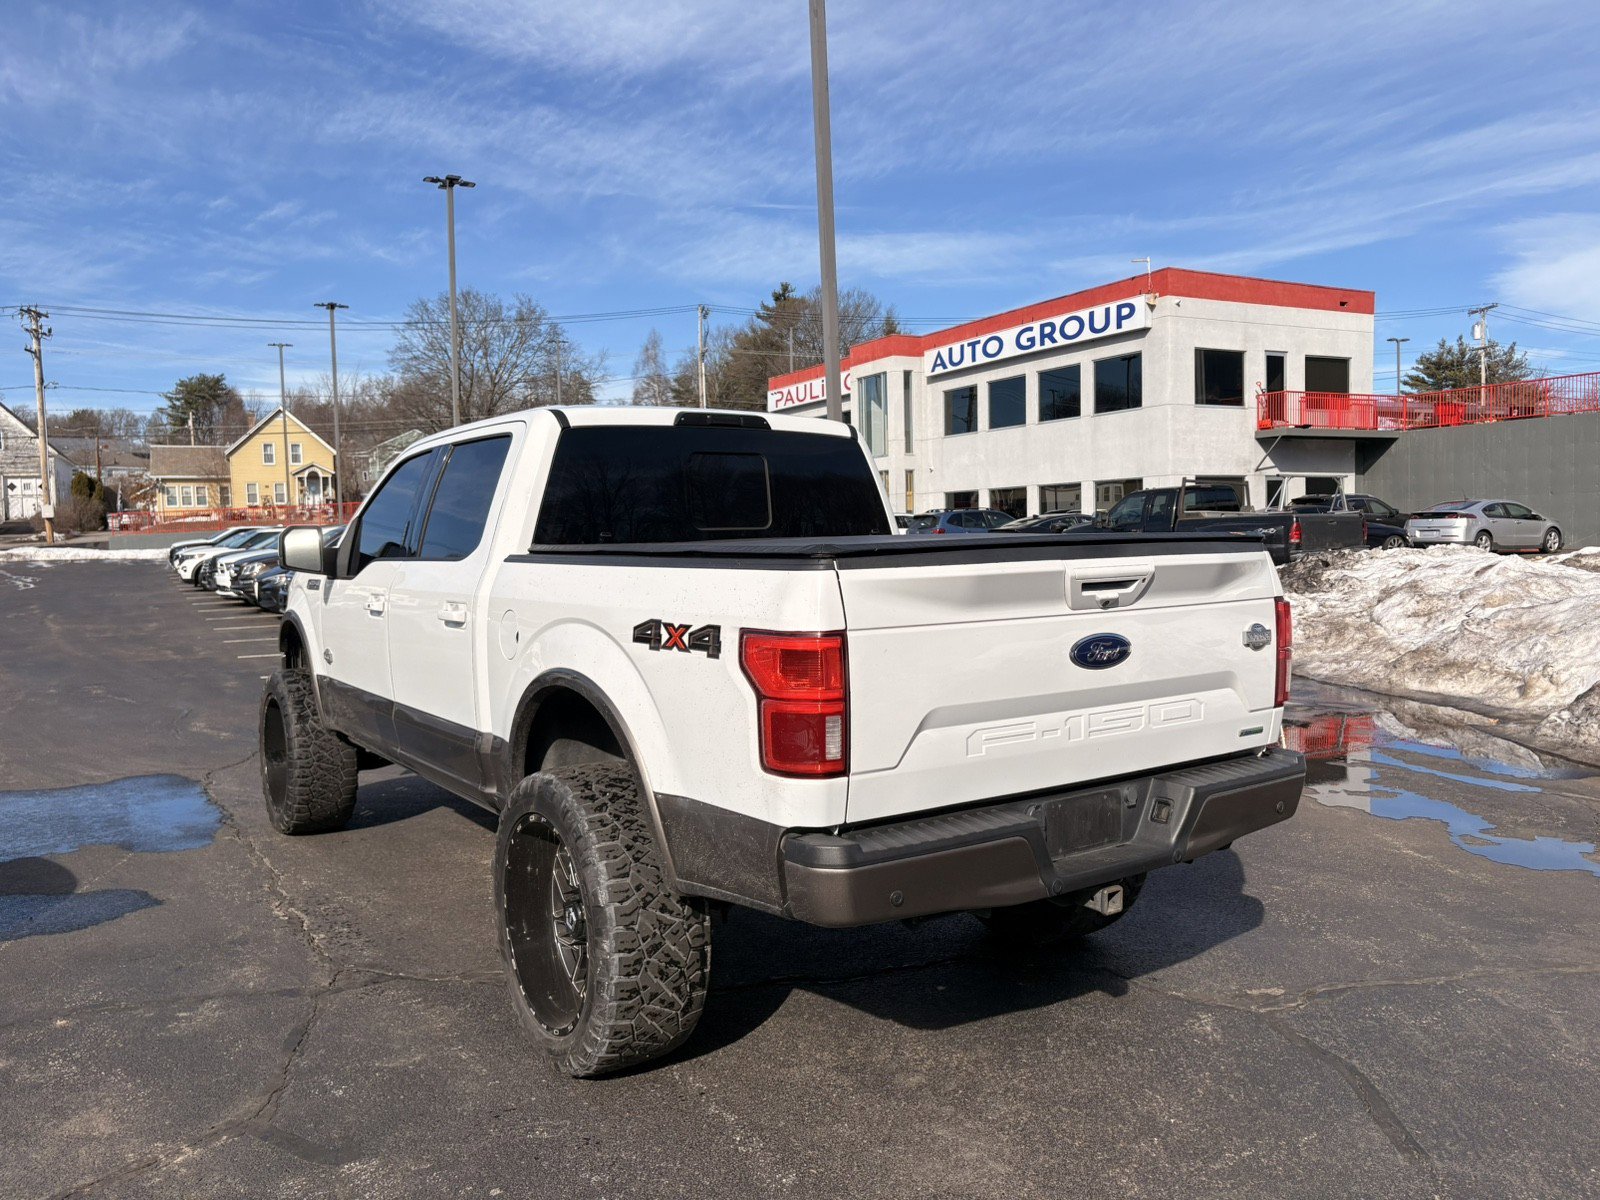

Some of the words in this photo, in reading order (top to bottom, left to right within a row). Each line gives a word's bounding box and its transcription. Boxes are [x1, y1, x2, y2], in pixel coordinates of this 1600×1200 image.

[931, 335, 1004, 373] AUTO
[1015, 302, 1136, 351] GROUP
[1086, 641, 1121, 662] Ford
[966, 698, 1205, 757] F-150
